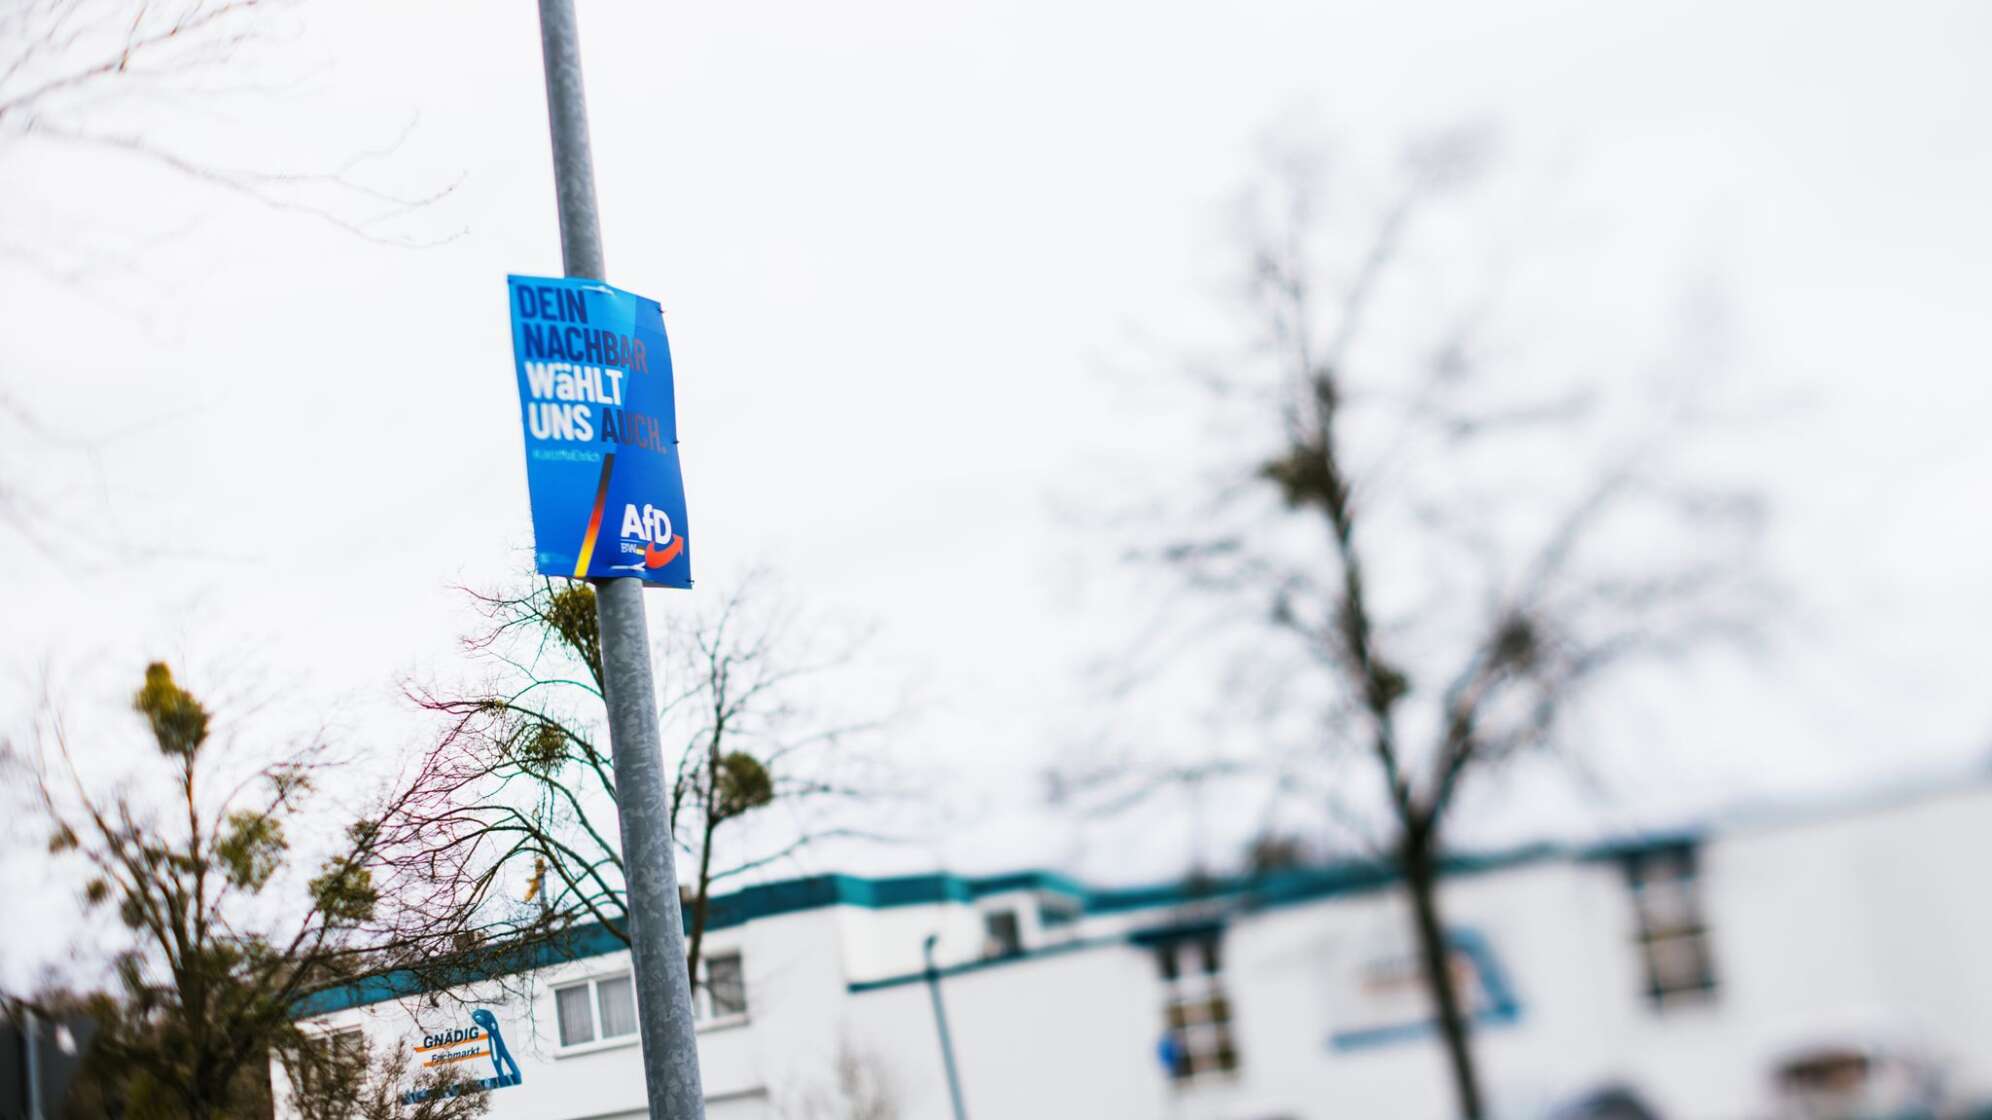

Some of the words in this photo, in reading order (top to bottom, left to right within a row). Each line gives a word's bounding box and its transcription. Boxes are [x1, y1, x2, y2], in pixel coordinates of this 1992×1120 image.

[517, 284, 588, 324] DEIN
[523, 322, 648, 374] NACHBAR
[528, 402, 594, 442] UNS
[601, 407, 667, 454] AUCH.
[620, 503, 672, 545] AfD
[424, 1026, 480, 1048] GNÄDIG
